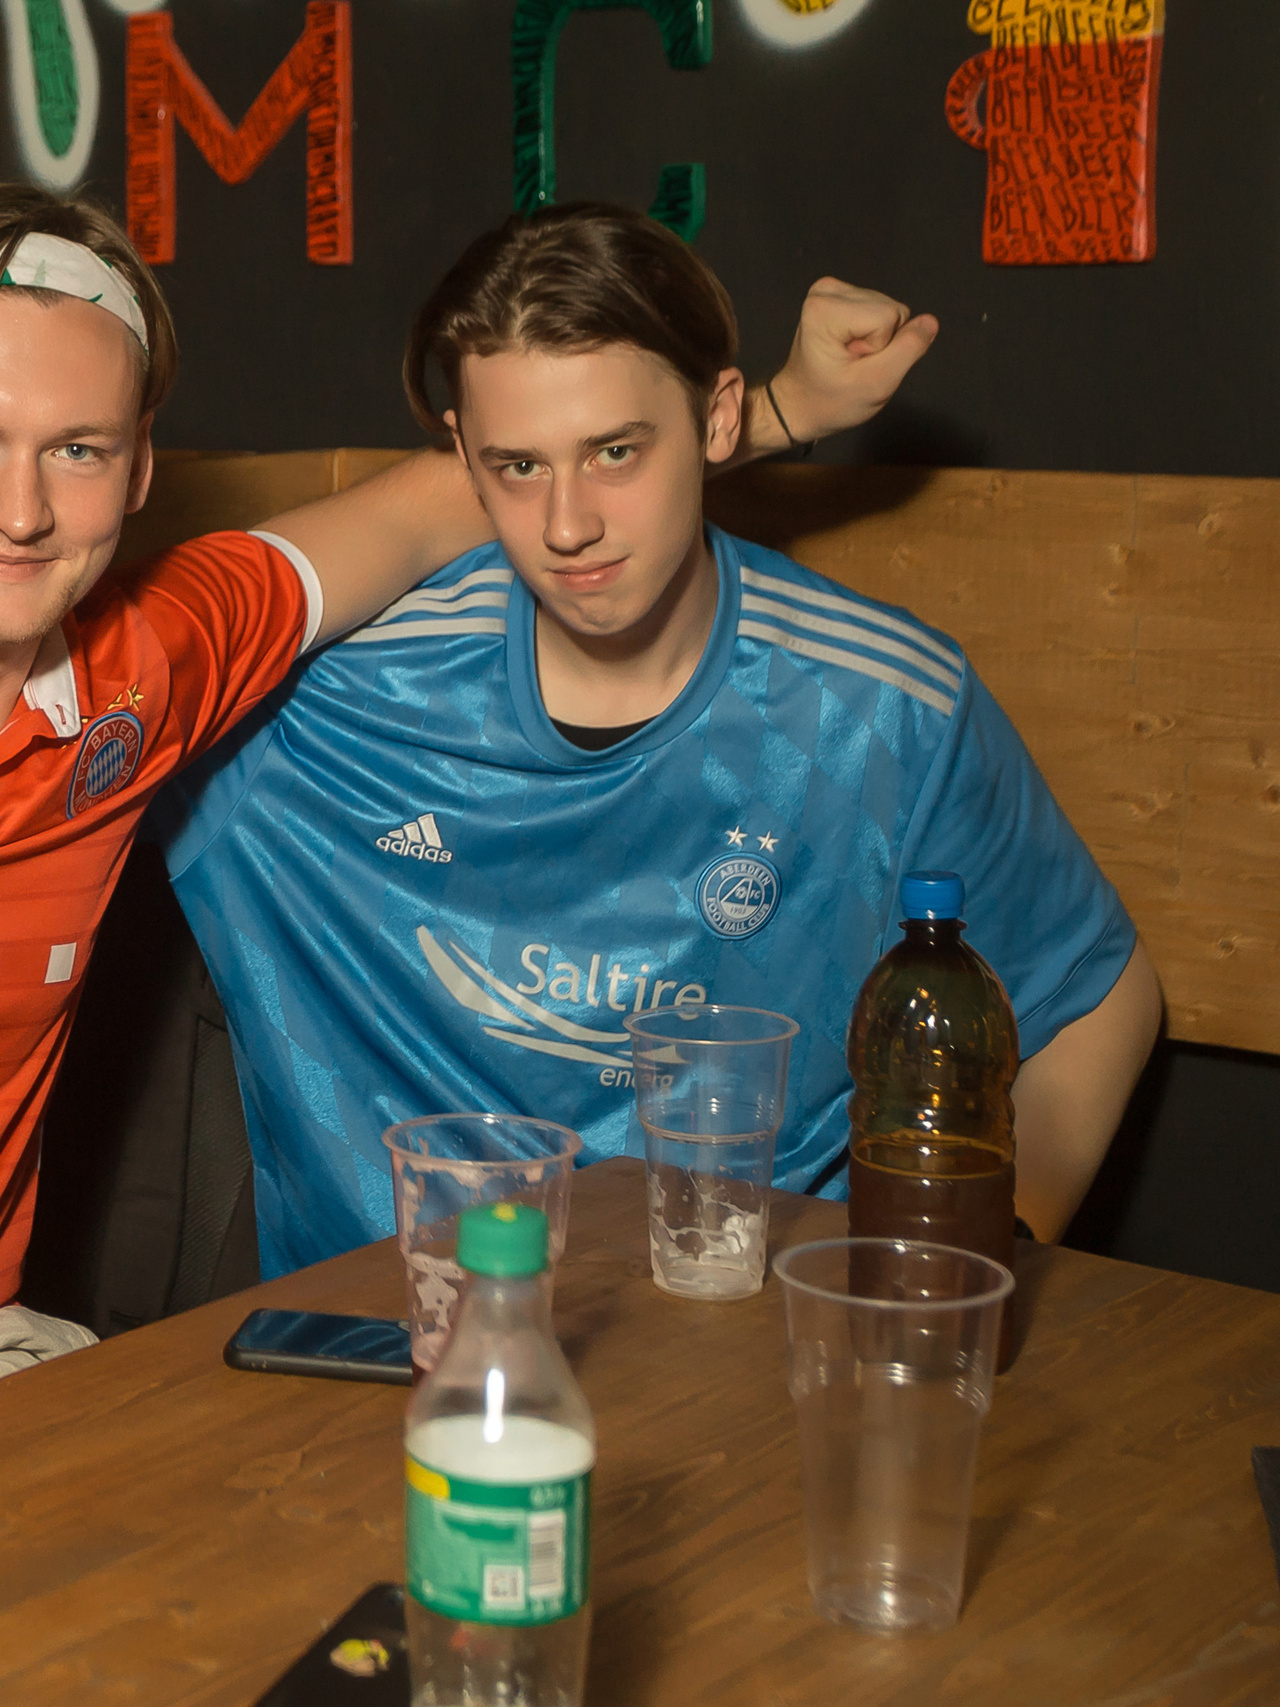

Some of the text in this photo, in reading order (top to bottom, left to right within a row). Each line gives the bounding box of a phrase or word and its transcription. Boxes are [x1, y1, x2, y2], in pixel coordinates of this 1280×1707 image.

[90, 721, 138, 753] BAYERN
[375, 834, 453, 864] adidas
[720, 863, 771, 887] ABERDEEN
[706, 897, 748, 932] FOOTBALL
[517, 943, 707, 1020] Saltire
